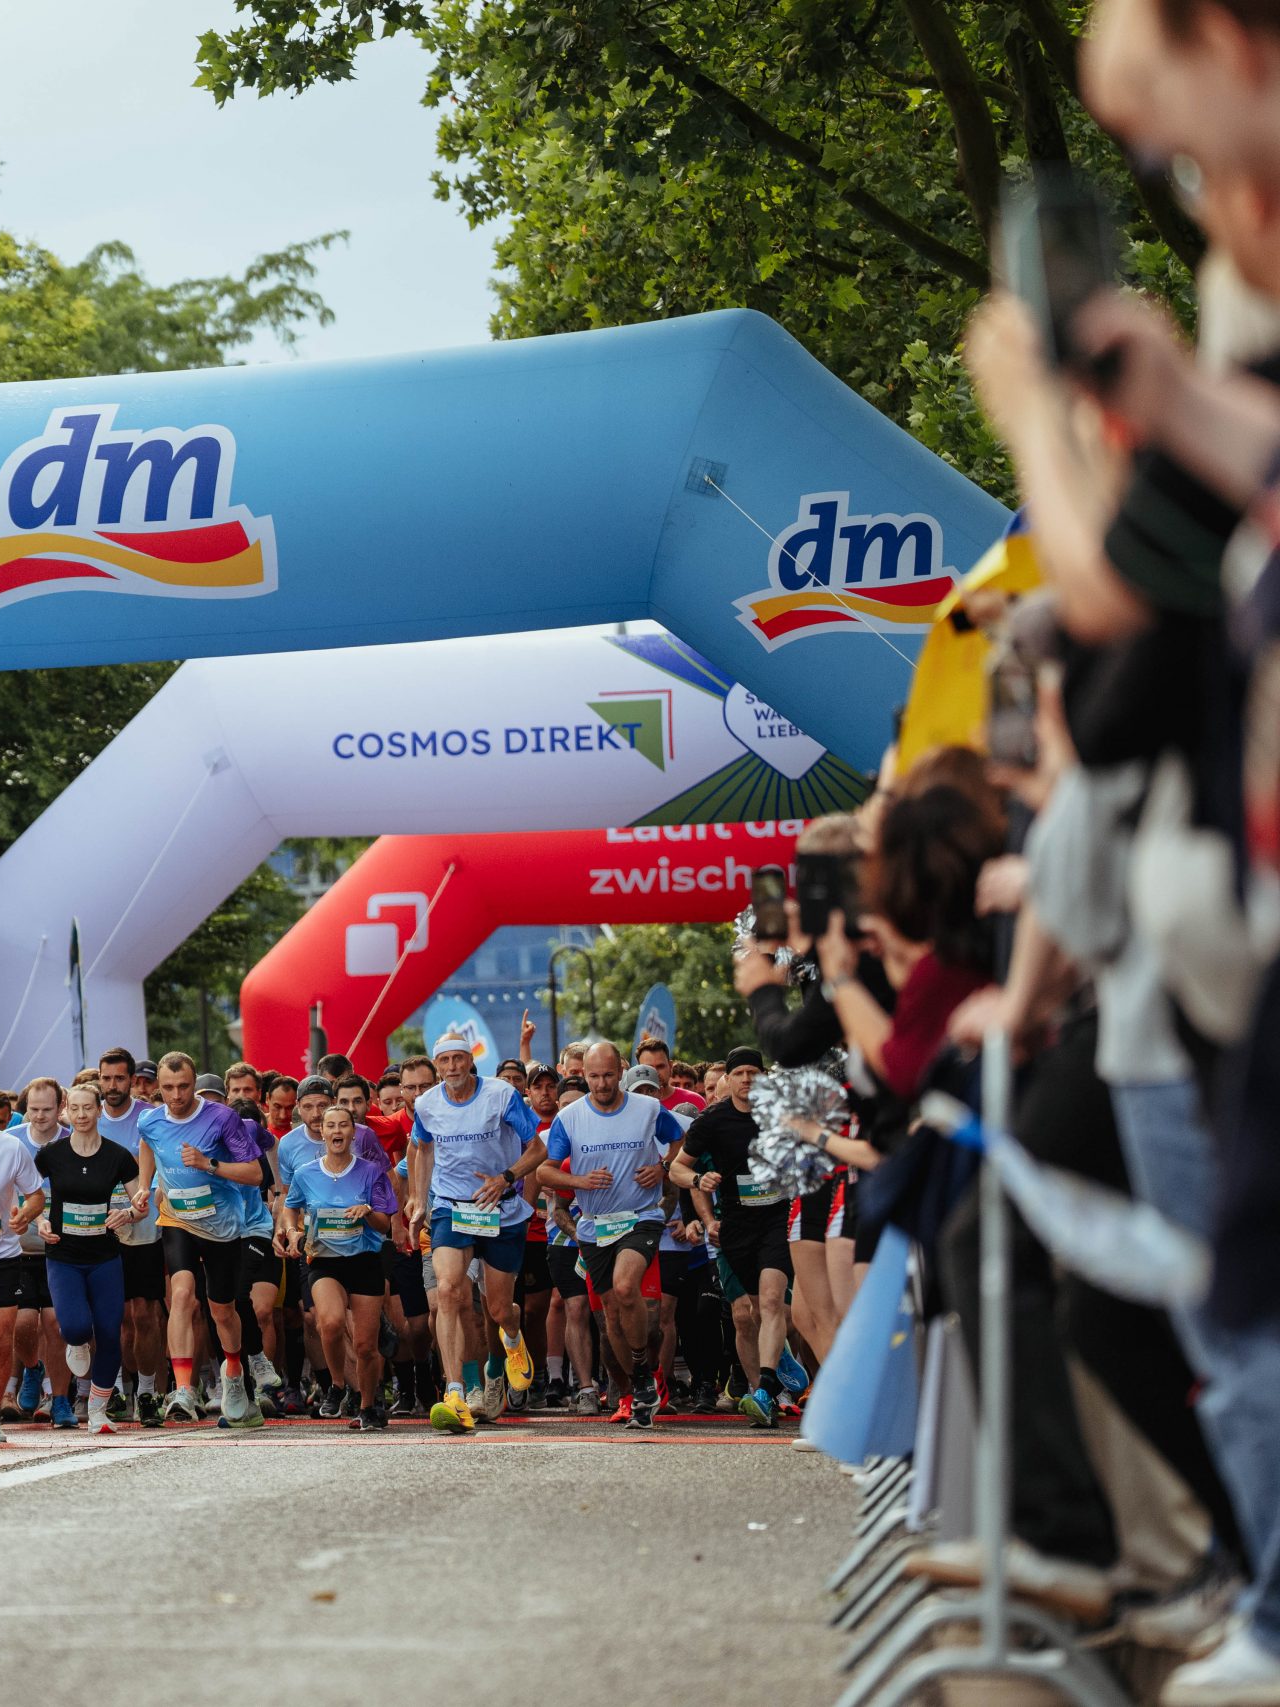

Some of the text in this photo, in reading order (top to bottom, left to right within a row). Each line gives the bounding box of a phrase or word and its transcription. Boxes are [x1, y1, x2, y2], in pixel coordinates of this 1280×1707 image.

[7, 413, 222, 530] dm
[778, 500, 933, 591] dm
[332, 722, 643, 760] COSMOS DIREKT
[588, 855, 798, 895] zwisch
[74, 1214, 95, 1222] Nadine
[460, 1213, 491, 1223] Wolfgang
[606, 1221, 629, 1231] Markus
